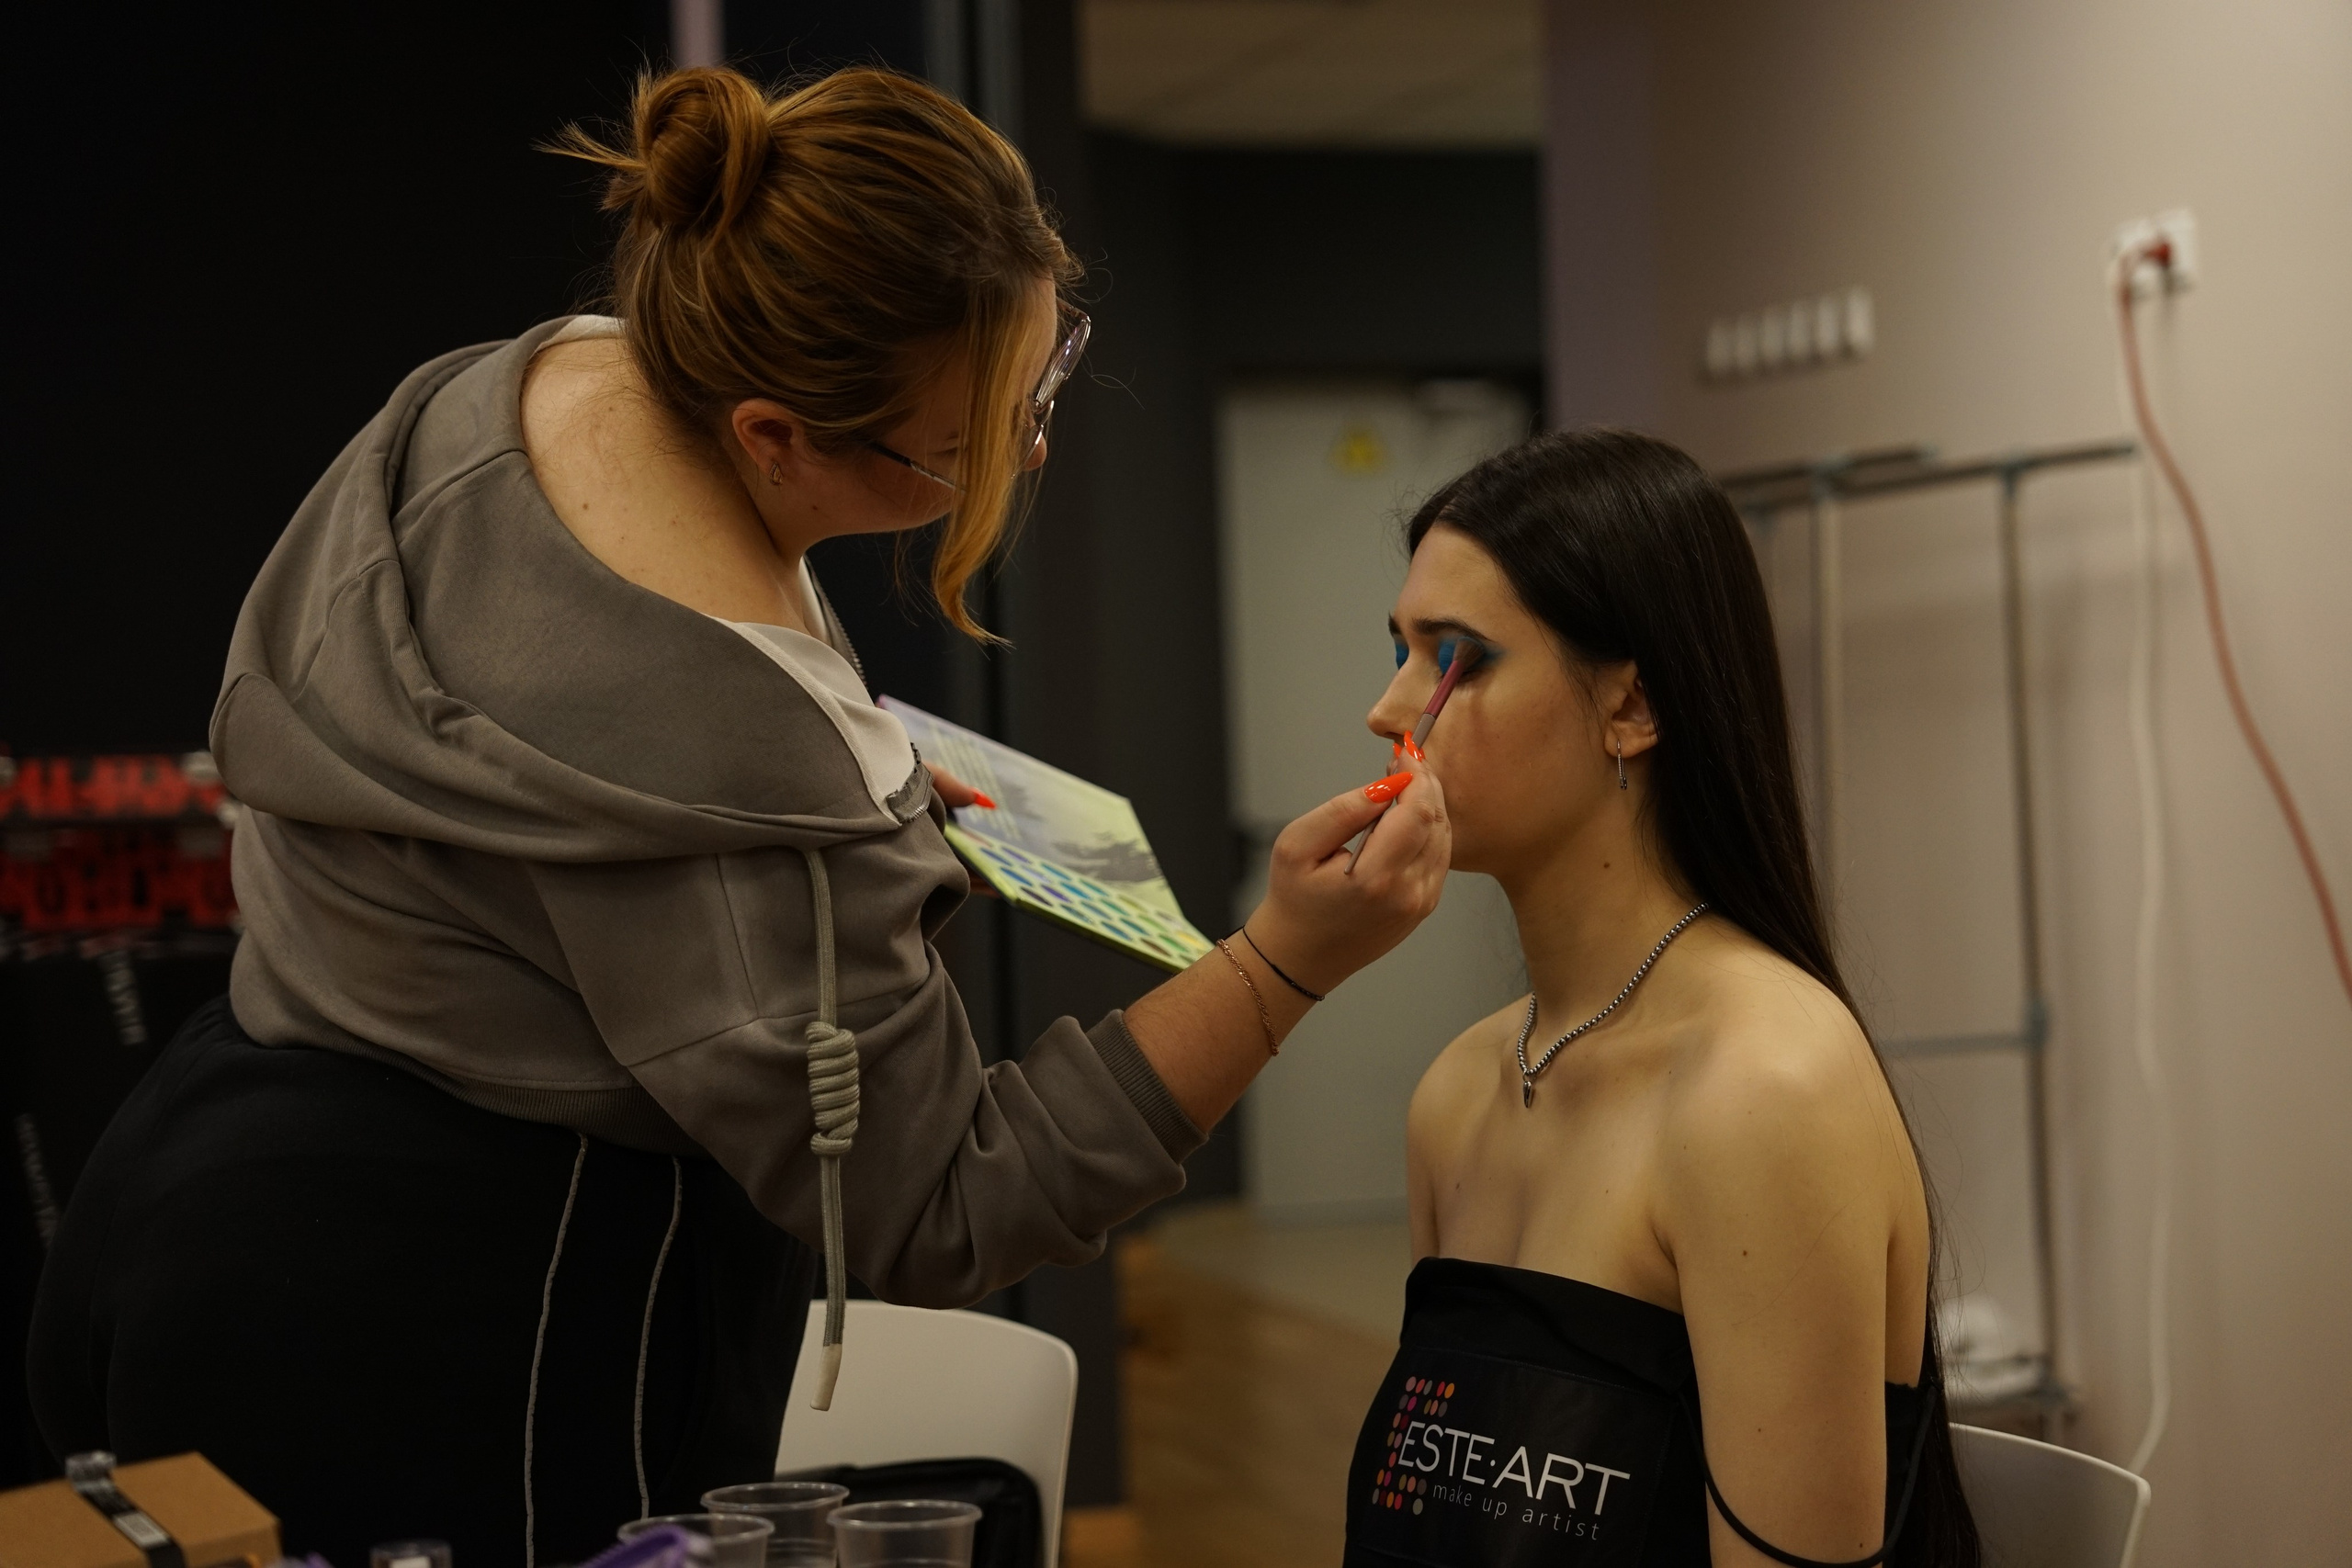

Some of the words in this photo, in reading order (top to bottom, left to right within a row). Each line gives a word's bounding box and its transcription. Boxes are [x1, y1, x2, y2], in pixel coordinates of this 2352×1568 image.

[1432, 1483, 1473, 1507] make
[1482, 1498, 1508, 1520] up
[1521, 1507, 1600, 1540] artist
